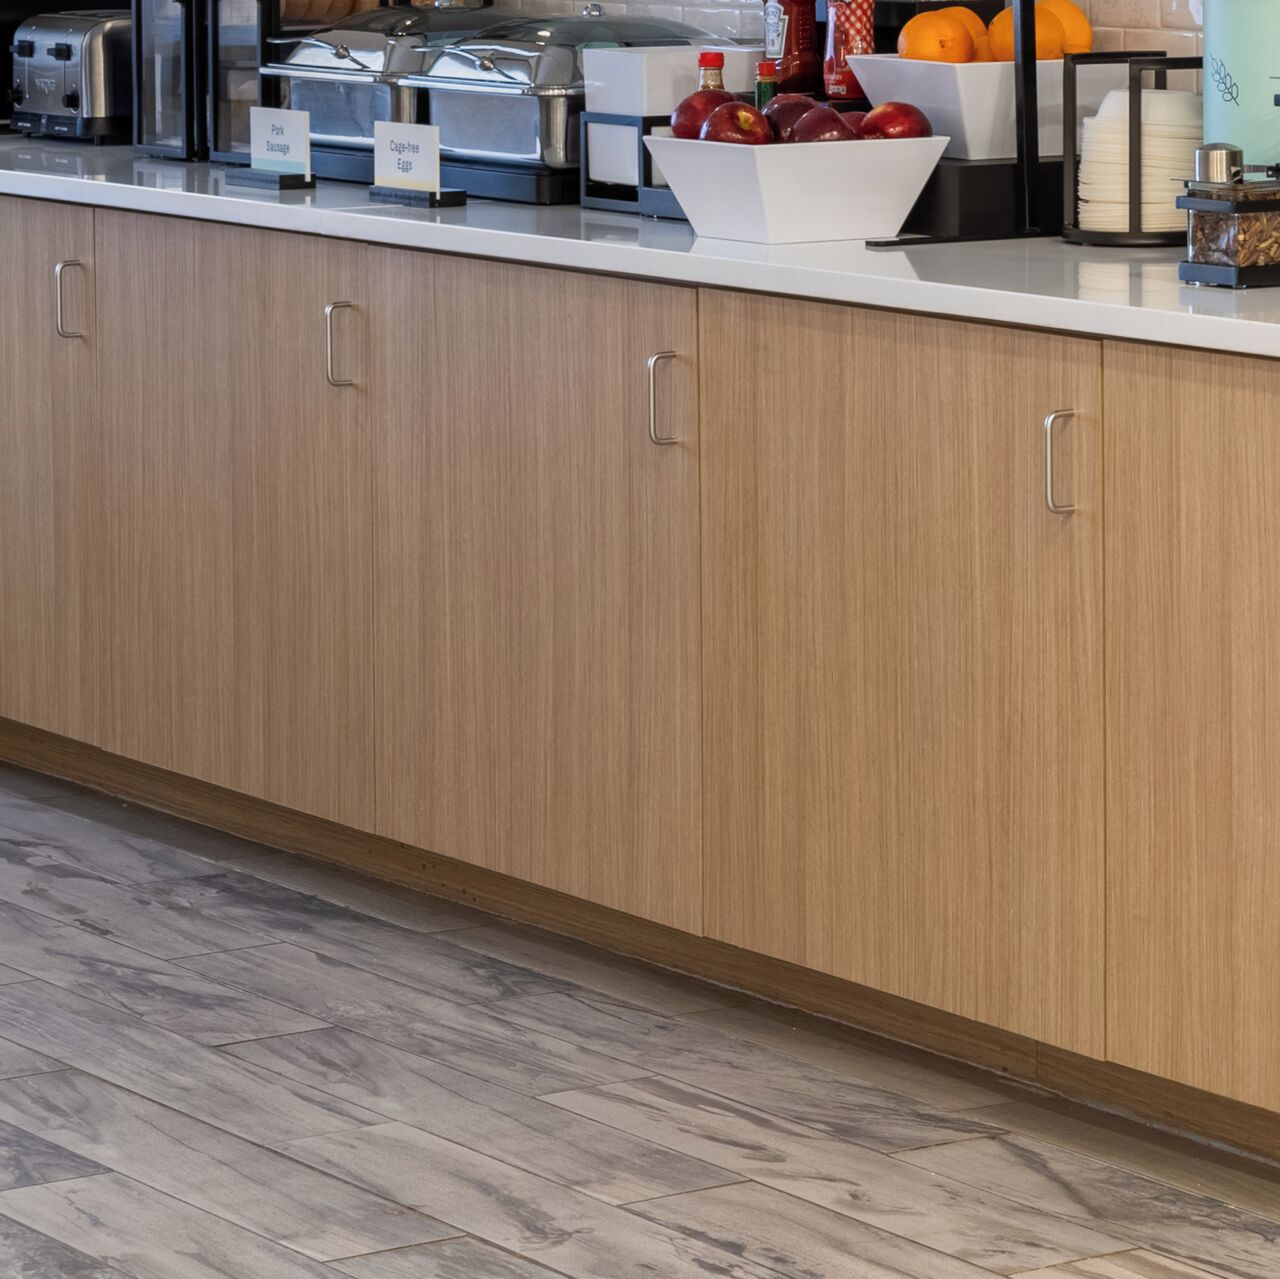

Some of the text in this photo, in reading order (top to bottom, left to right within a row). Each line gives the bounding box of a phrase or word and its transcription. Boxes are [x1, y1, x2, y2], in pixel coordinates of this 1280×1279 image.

[272, 124, 284, 136] Pork
[266, 140, 290, 155] Sausage
[390, 140, 419, 155] Cage-free
[397, 158, 412, 173] Eggs
